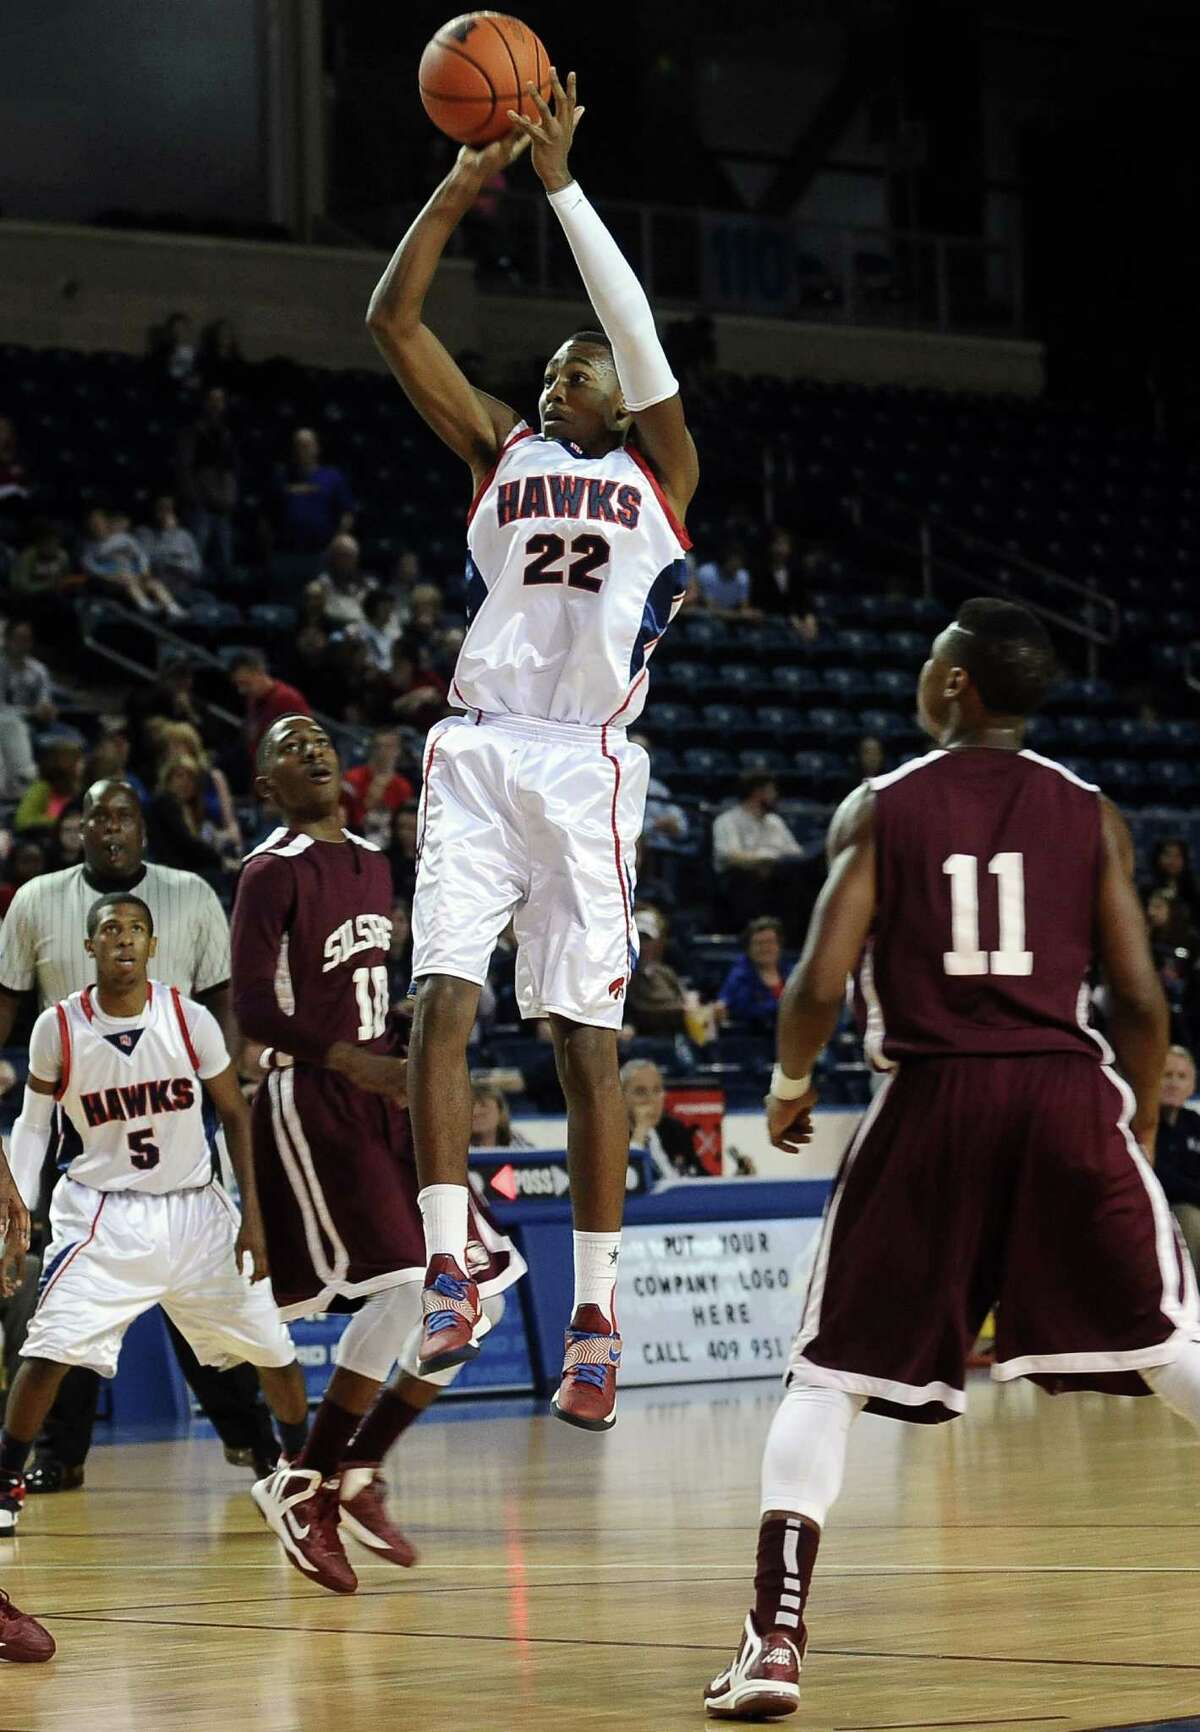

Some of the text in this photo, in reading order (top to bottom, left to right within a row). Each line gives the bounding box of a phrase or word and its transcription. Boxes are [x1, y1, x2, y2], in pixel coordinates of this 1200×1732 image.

[497, 474, 642, 530] HAWKS
[523, 533, 610, 593] 22
[942, 852, 1034, 976] 11
[80, 1077, 195, 1128] HAWKS
[127, 1127, 160, 1170] 5
[512, 1166, 553, 1195] POSS
[663, 1232, 770, 1255] PUT YOUR
[634, 1268, 789, 1298] COMPANY LOGO
[692, 1303, 750, 1327] HERE
[642, 1340, 691, 1365] CALL
[707, 1339, 739, 1361] 409
[770, 1647, 792, 1657] AIR
